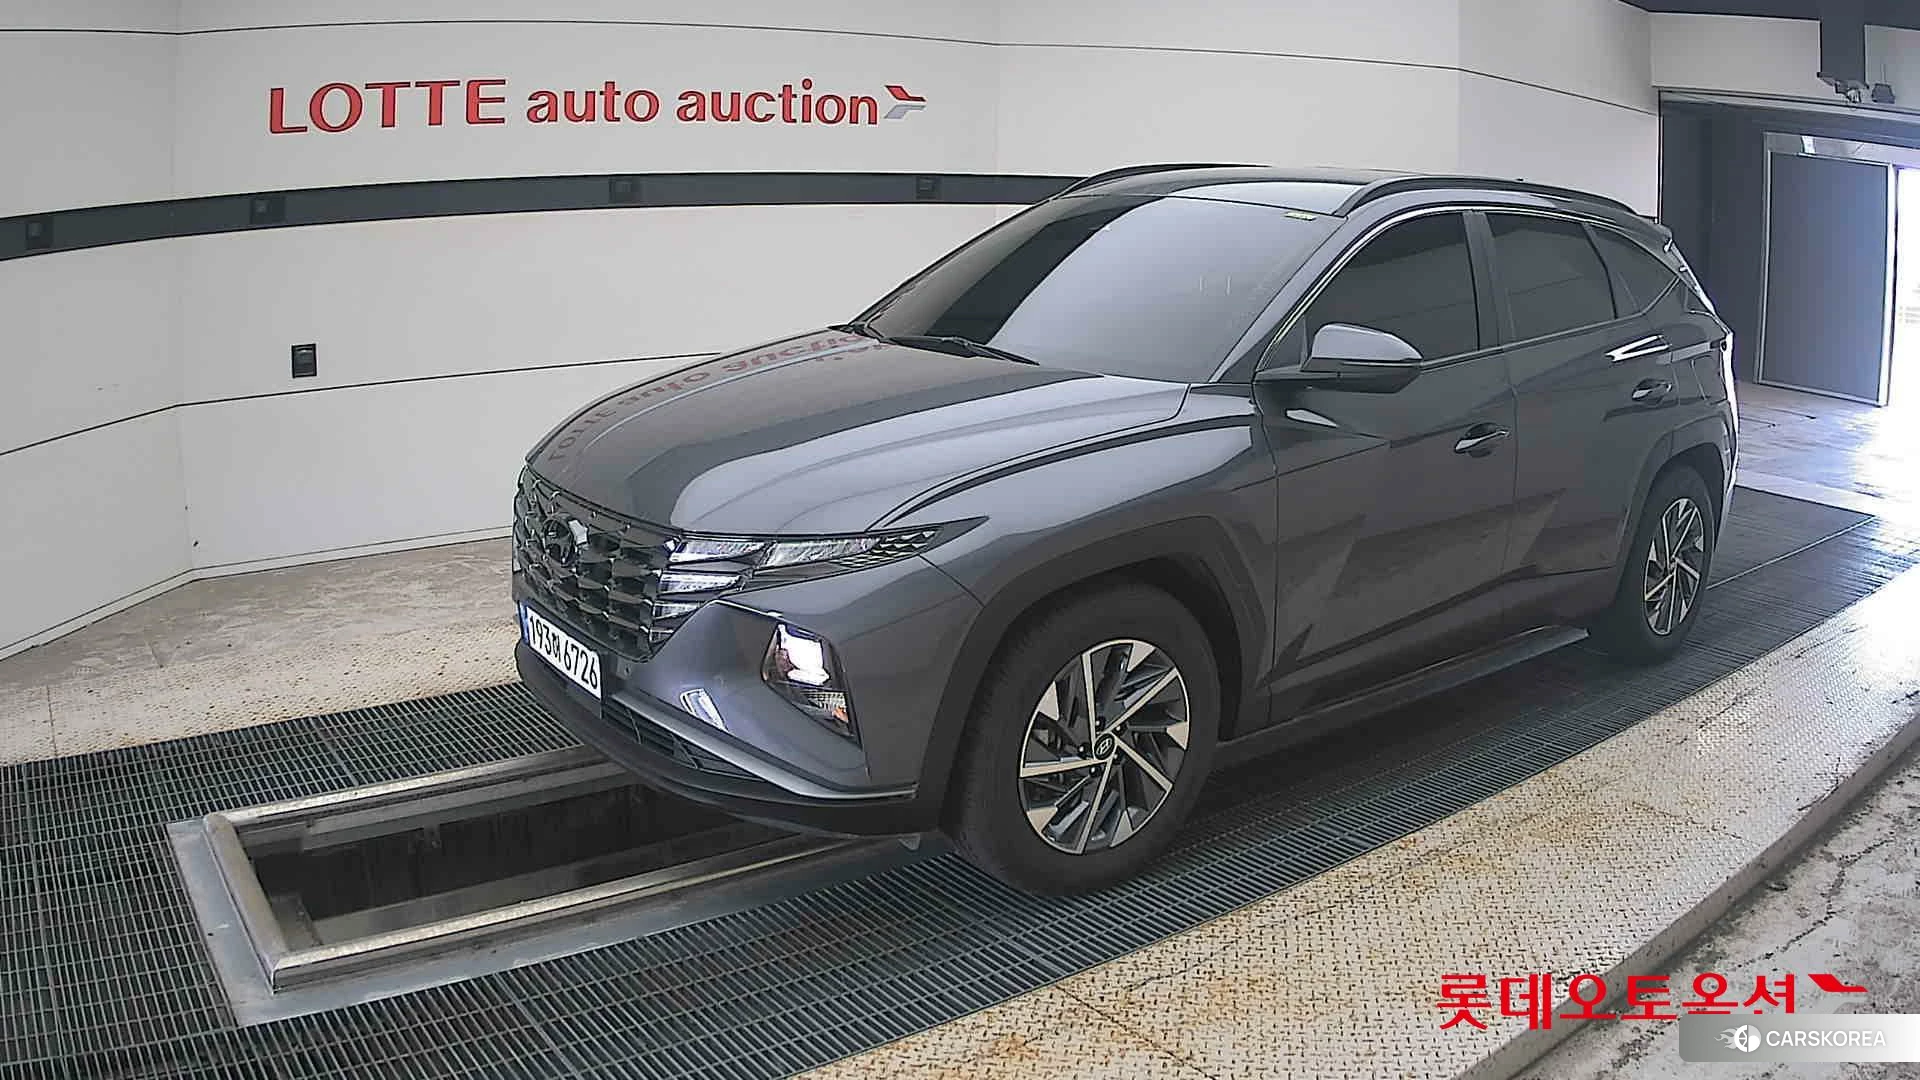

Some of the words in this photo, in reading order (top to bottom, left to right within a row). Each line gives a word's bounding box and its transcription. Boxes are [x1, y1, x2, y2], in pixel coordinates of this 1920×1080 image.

[269, 79, 507, 135] LOTTE
[526, 80, 661, 124] auto
[676, 78, 879, 126] auction
[564, 639, 598, 690] 6726
